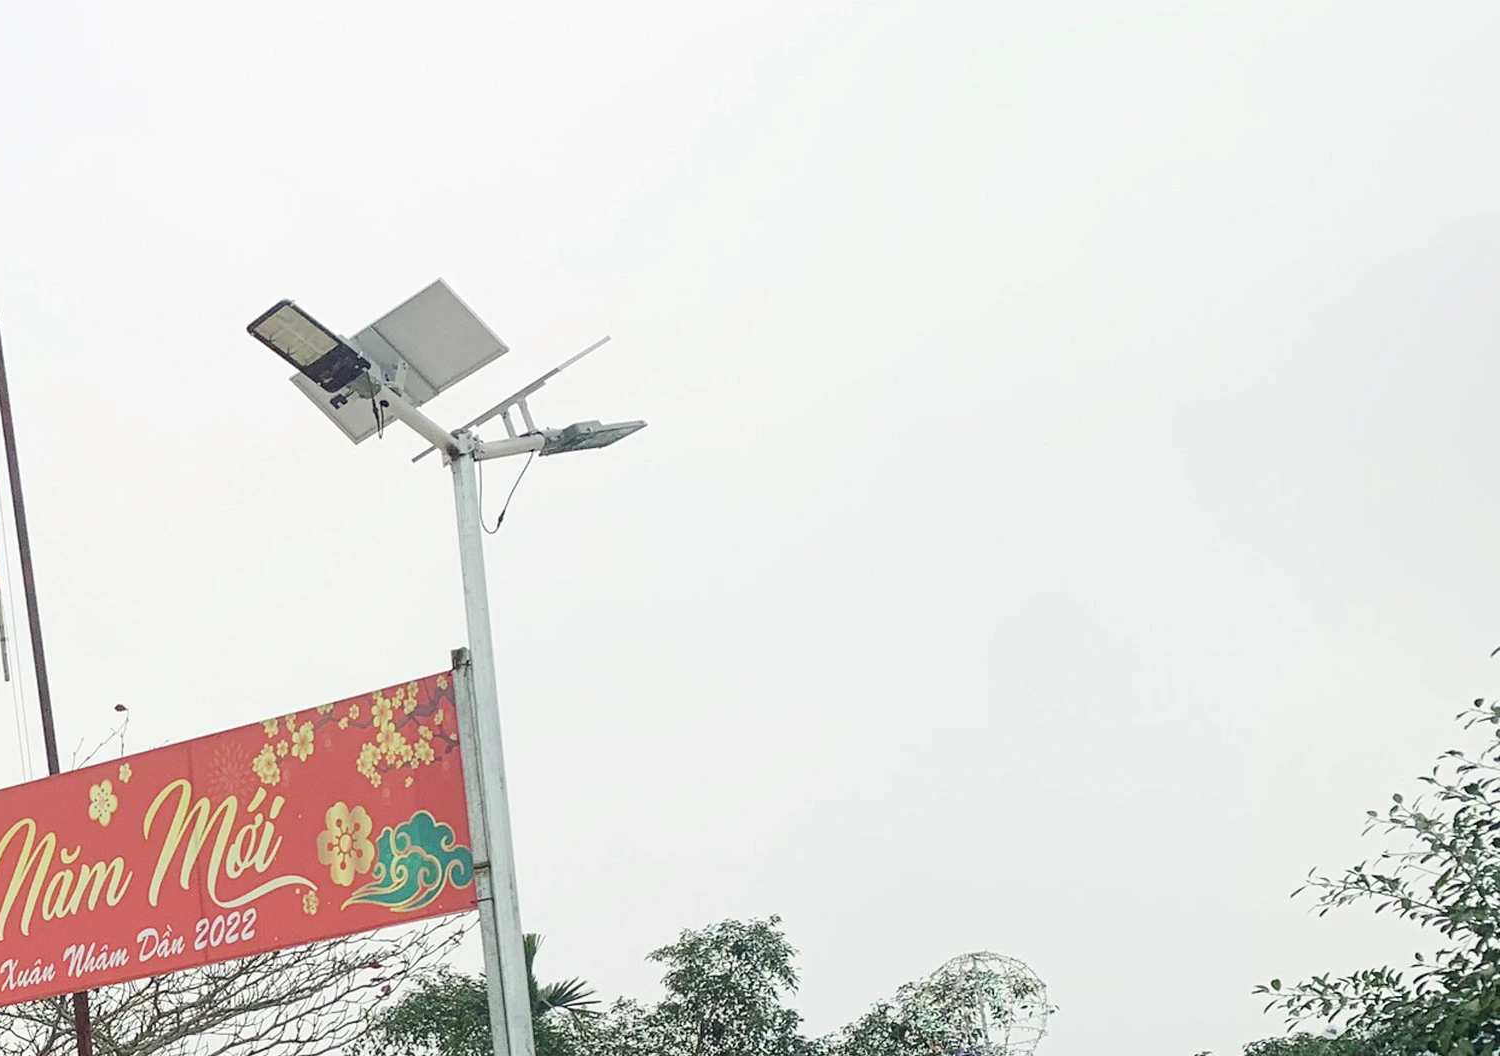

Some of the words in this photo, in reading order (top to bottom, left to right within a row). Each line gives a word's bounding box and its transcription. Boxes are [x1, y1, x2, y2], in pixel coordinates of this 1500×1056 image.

[143, 779, 318, 908] Mới
[0, 958, 56, 992] Xuân
[62, 942, 129, 978] Nhâm
[136, 924, 186, 962] Dần
[193, 907, 257, 950] 2022
